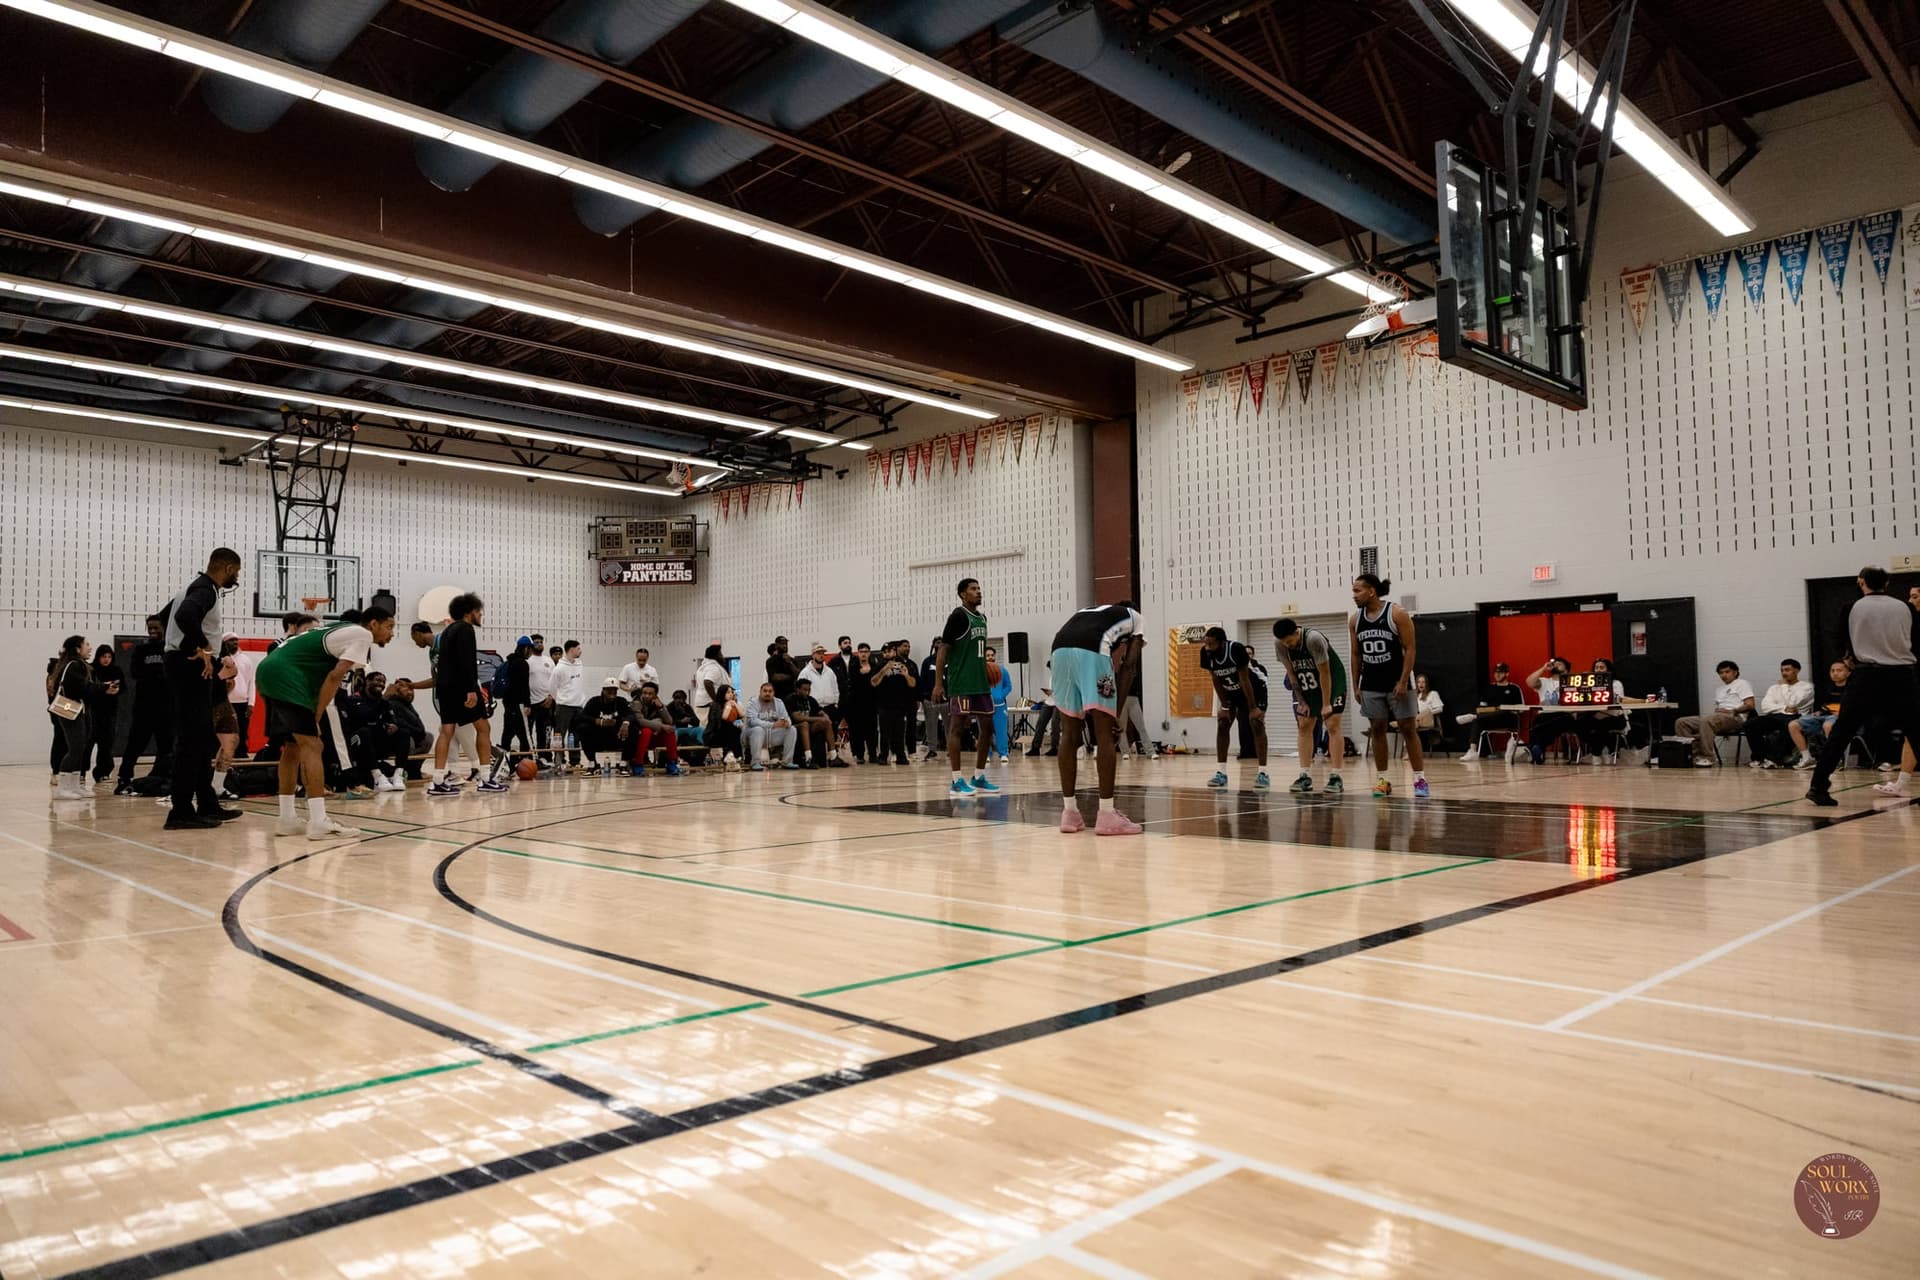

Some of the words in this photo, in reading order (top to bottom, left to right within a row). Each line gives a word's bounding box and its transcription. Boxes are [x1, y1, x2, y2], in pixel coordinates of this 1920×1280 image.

[630, 563, 654, 571] HOME
[655, 562, 667, 570] OF
[667, 562, 685, 570] THE
[622, 570, 693, 582] PANTHERS
[1363, 640, 1386, 653] 00
[1298, 672, 1318, 691] 33
[1564, 692, 1579, 702] 26
[1594, 691, 1609, 702] 22
